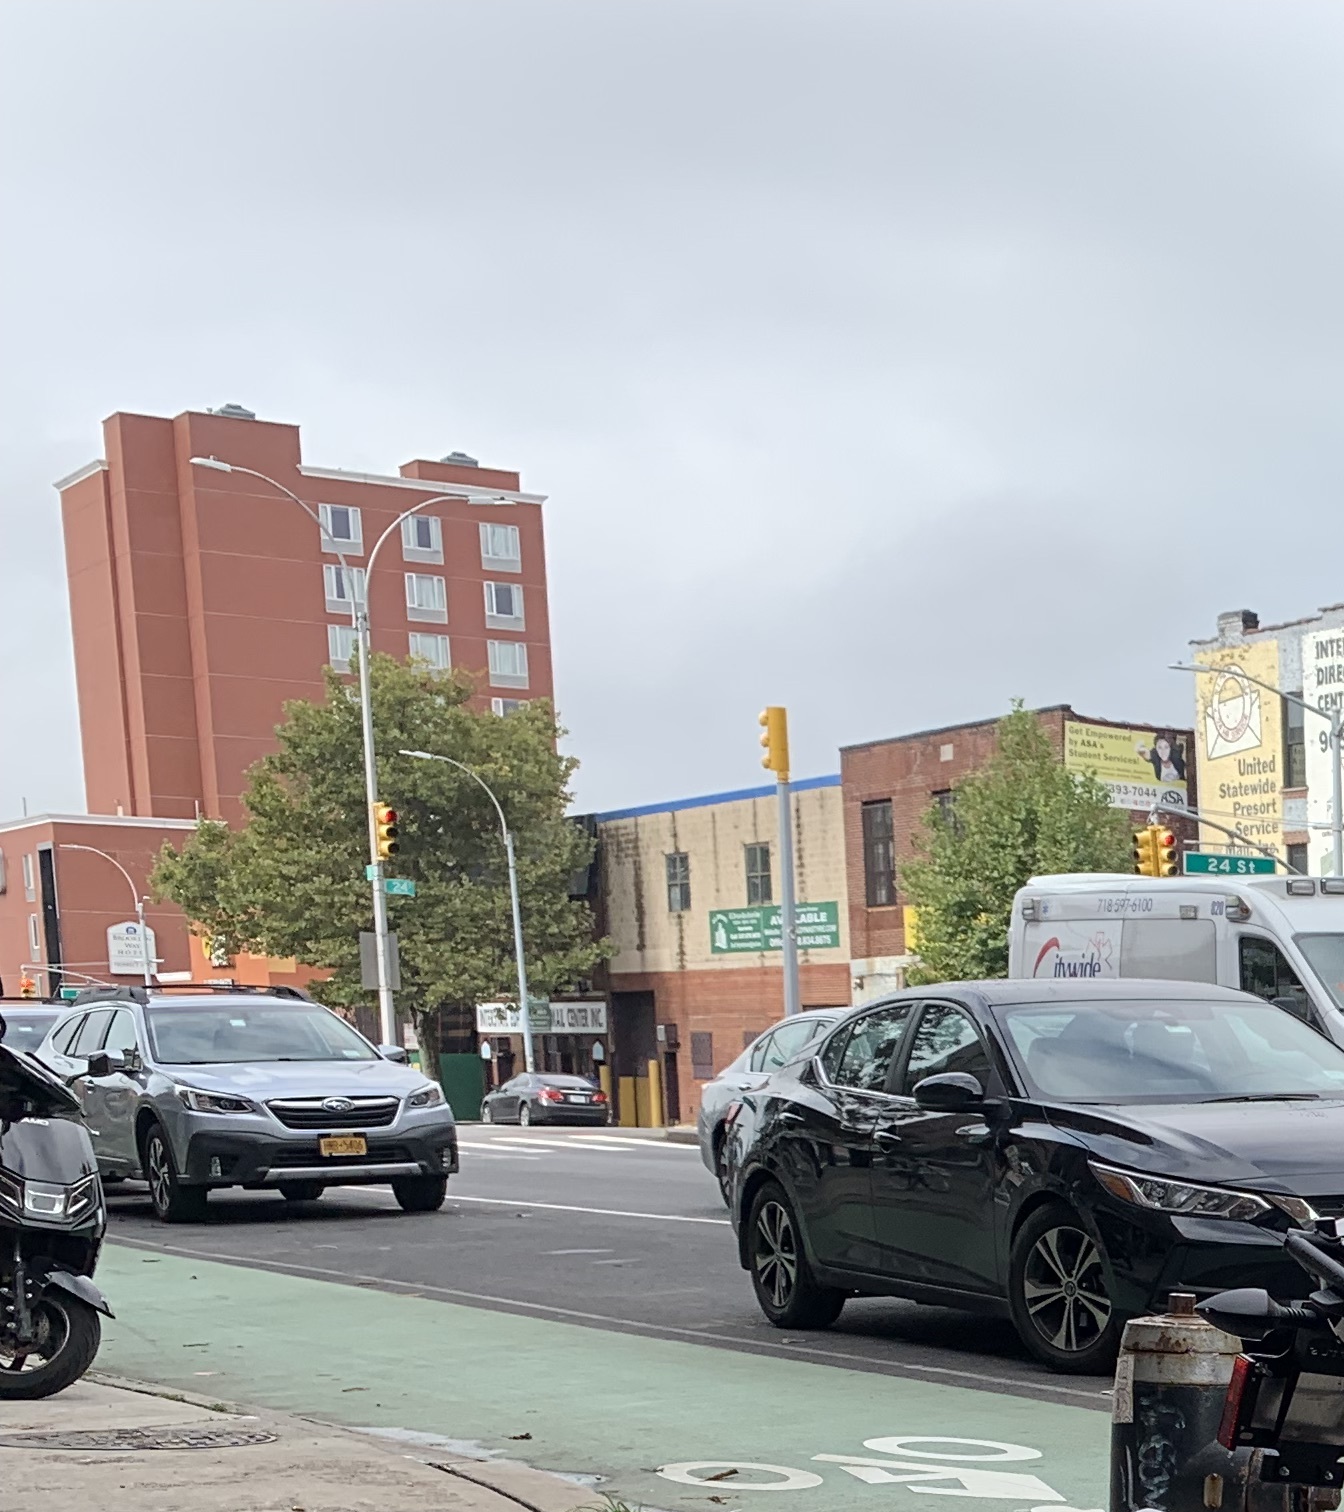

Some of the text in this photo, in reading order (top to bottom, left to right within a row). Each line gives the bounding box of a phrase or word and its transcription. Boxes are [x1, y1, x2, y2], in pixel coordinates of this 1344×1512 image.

[1069, 738, 1078, 746] by
[1086, 728, 1132, 742] Empowered
[1069, 748, 1140, 764] Student Services!
[1238, 755, 1276, 777] United
[1161, 790, 1184, 804] ASA
[1219, 778, 1277, 800] Statewide
[1233, 800, 1277, 817] Presort
[1235, 821, 1279, 837] Service
[1208, 857, 1255, 874] 24 St
